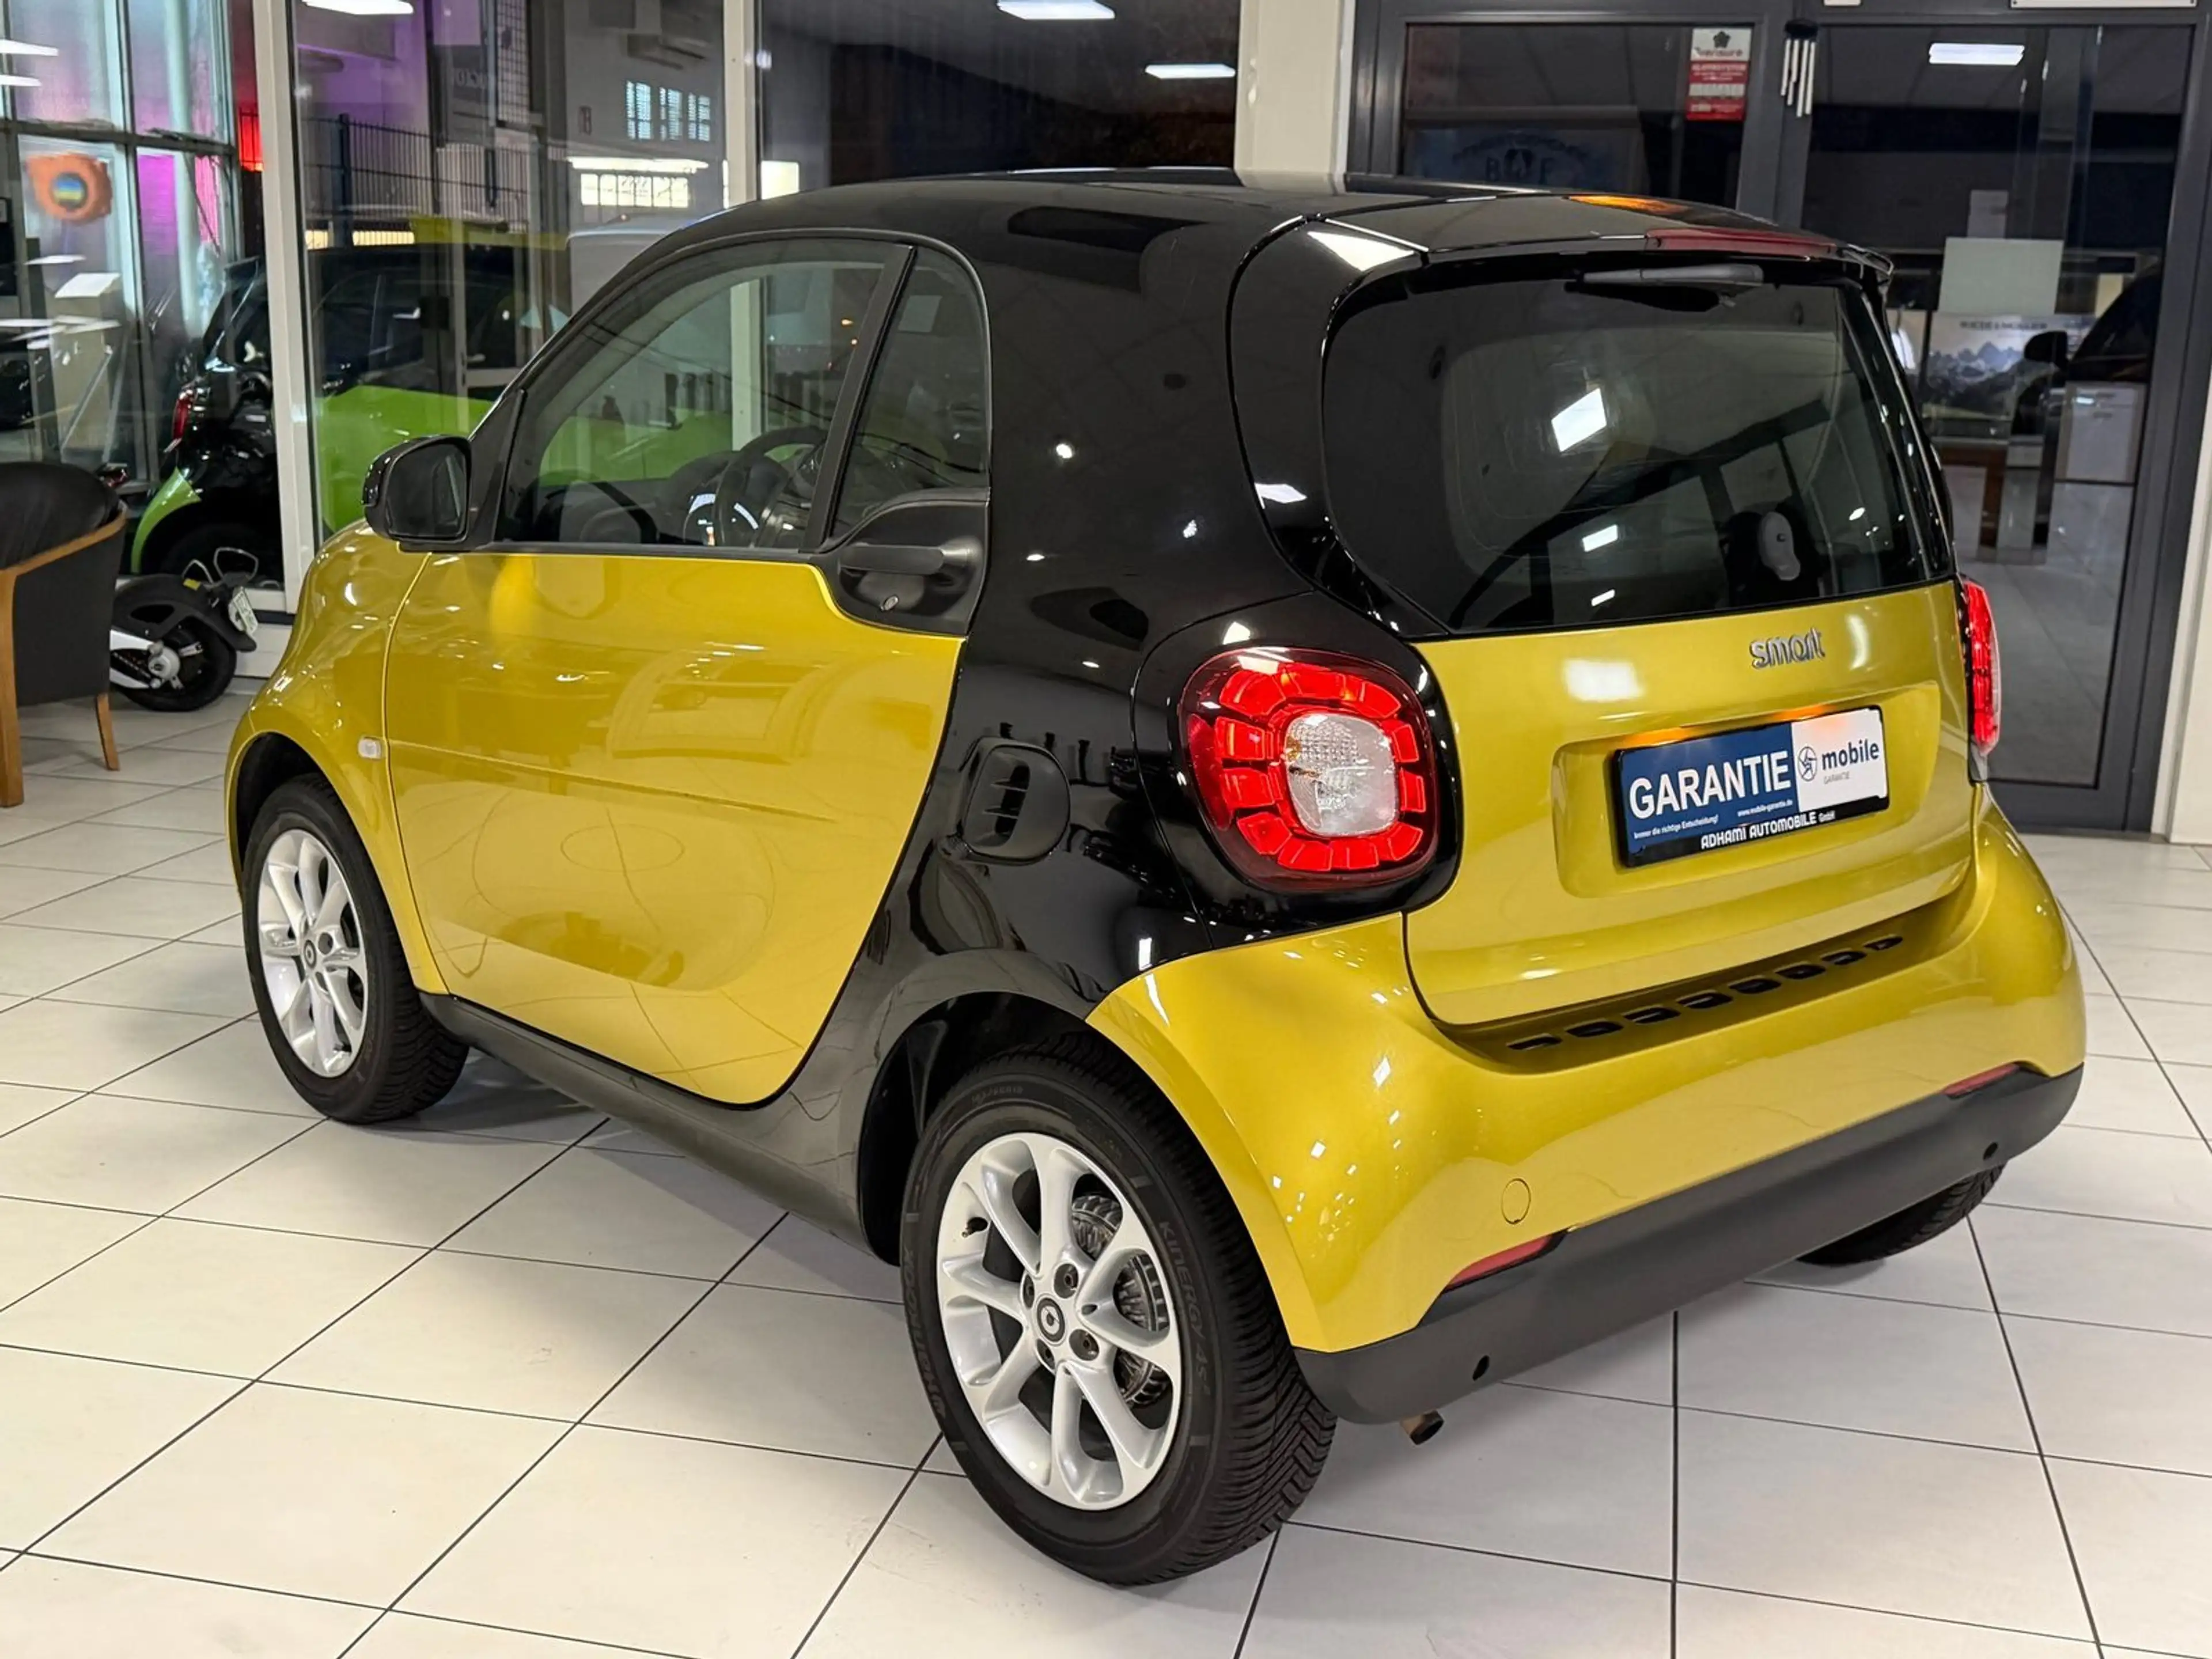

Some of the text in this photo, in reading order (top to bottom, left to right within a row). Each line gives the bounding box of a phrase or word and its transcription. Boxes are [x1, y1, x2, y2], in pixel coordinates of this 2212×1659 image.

[1749, 626, 1825, 669] smart
[1821, 738, 1879, 771] mobile
[1630, 751, 1791, 819] GARANTIE
[1700, 827, 1747, 850] ADHAMI
[1749, 811, 1817, 839] AUTOMOBILE
